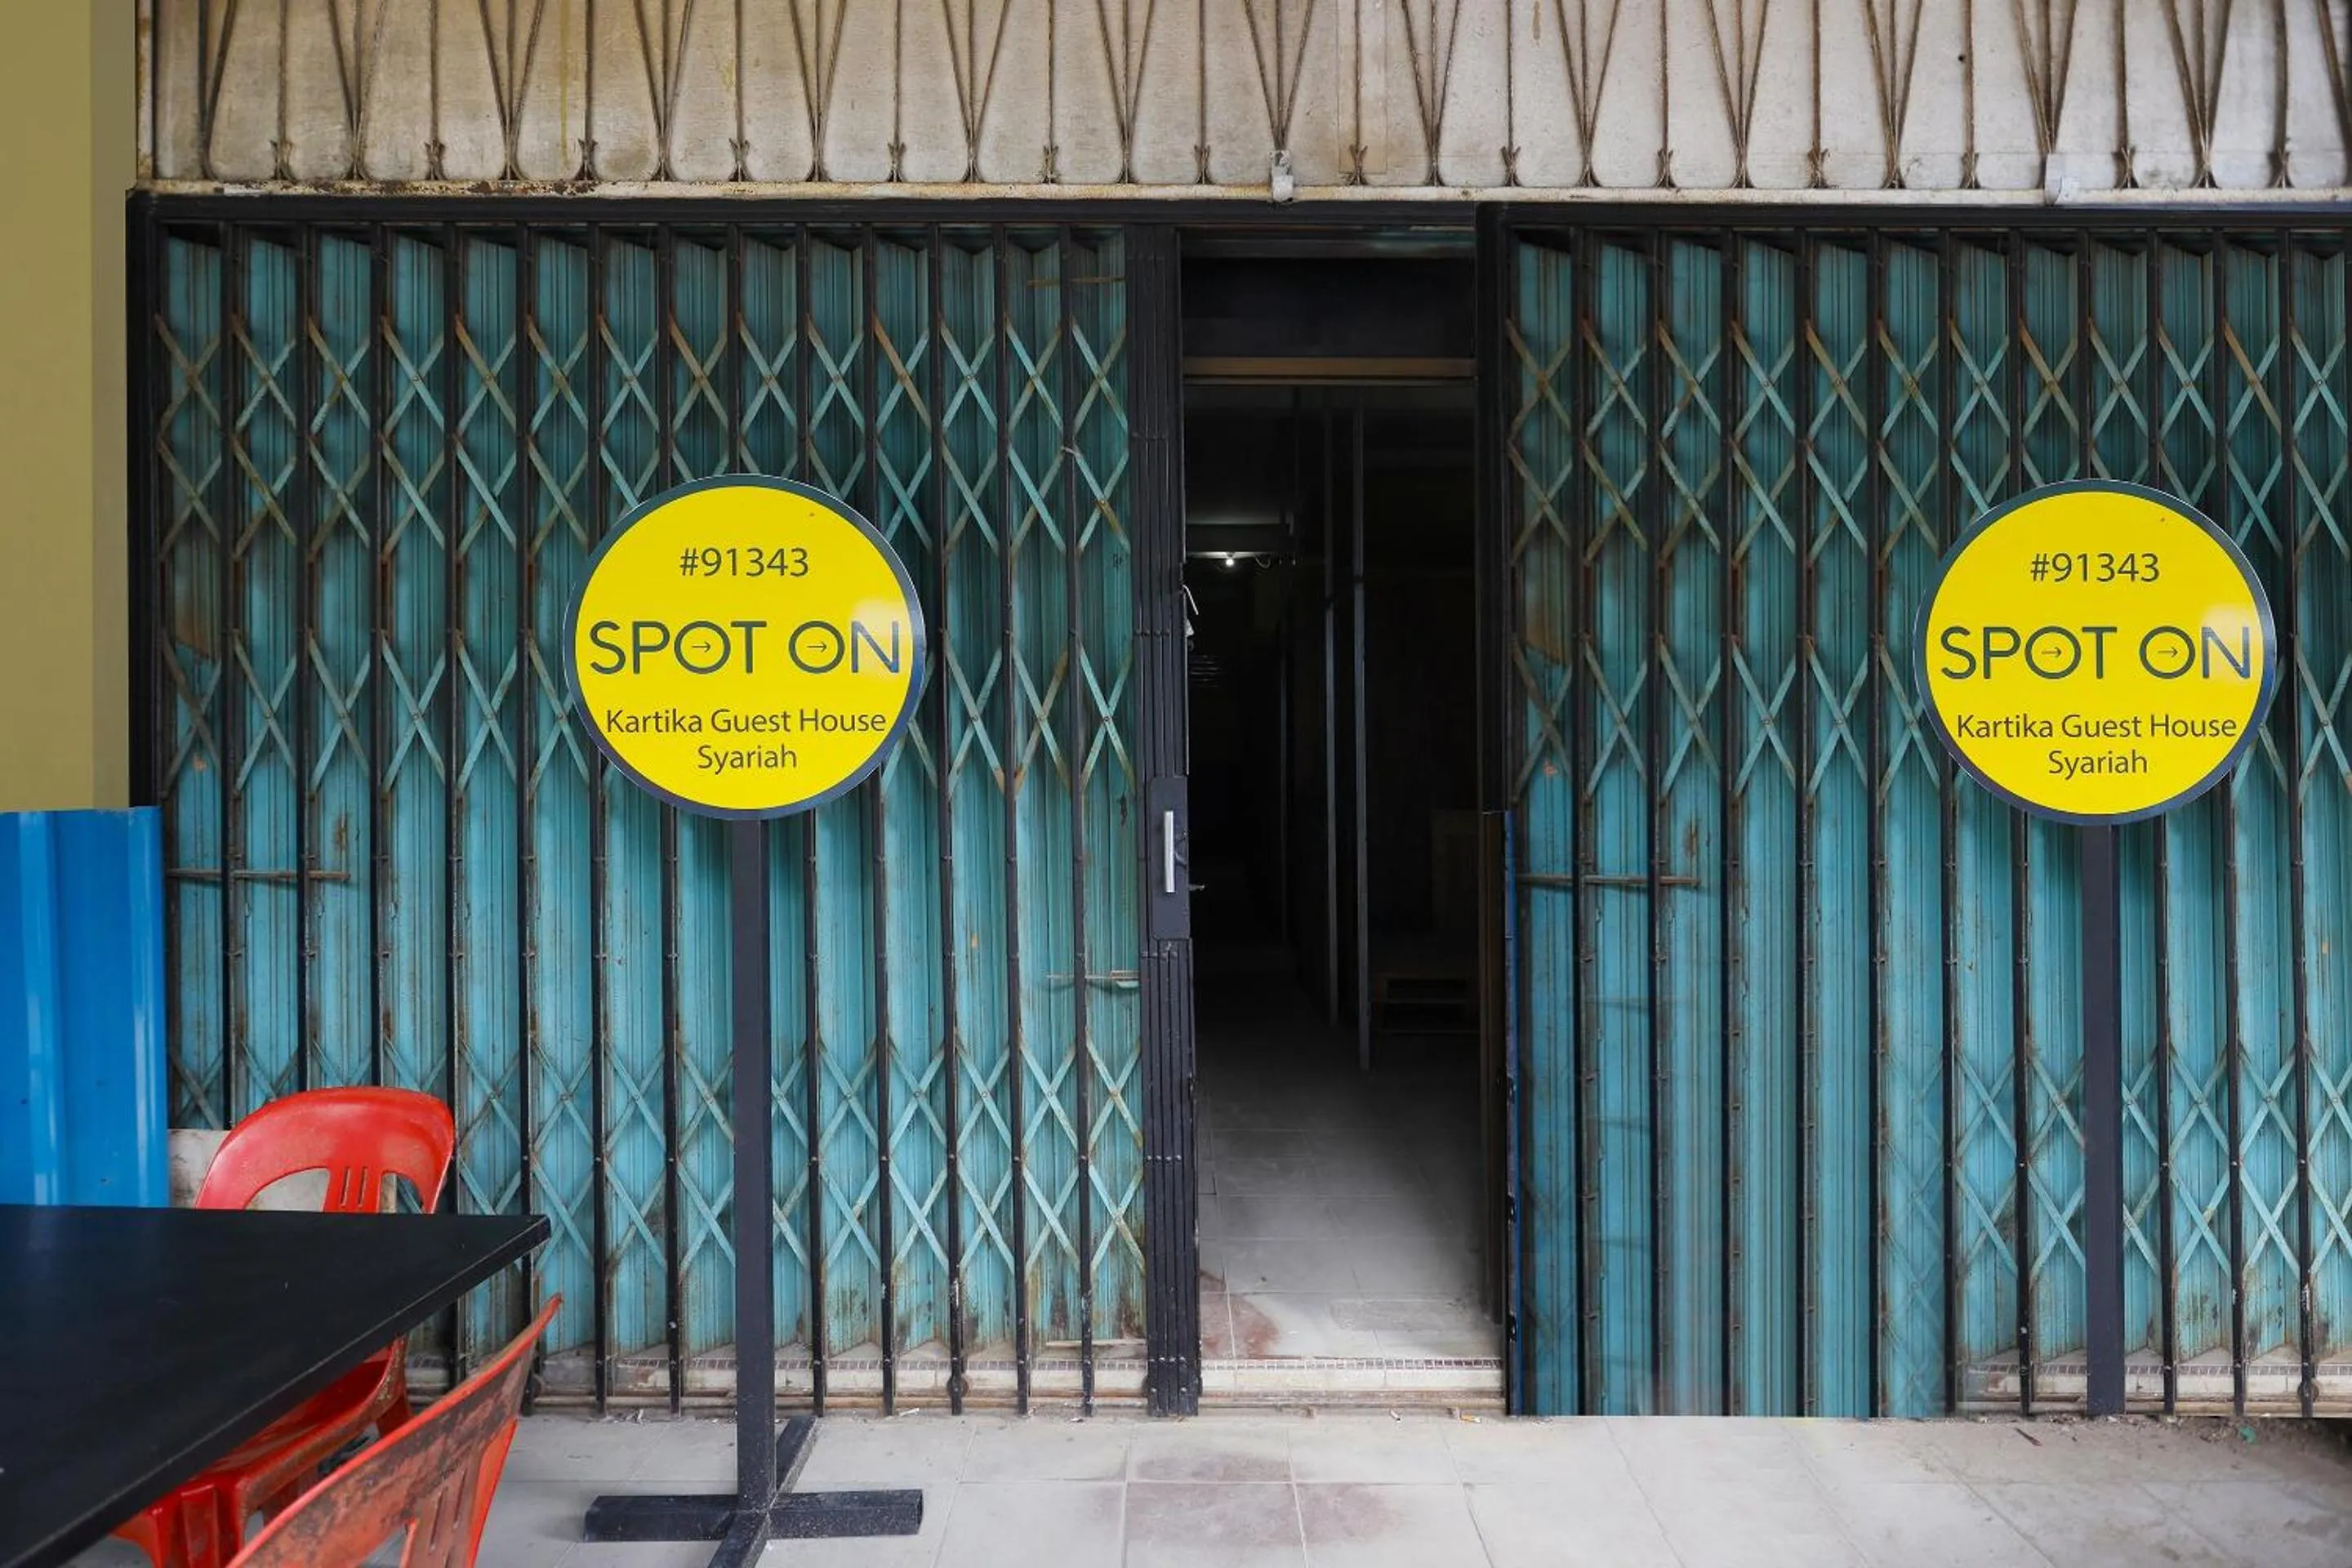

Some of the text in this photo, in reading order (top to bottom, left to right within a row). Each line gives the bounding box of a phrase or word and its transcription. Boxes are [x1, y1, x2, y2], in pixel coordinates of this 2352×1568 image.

[679, 547, 809, 577] #91343
[2030, 552, 2160, 582] #91343
[589, 620, 900, 675] SPOT ON
[1940, 626, 2251, 680] SPOT ON
[606, 708, 887, 733] Kartika Guest House
[1957, 713, 2237, 738] Kartika Guest House
[697, 744, 797, 775] Syariah
[2048, 749, 2148, 780] Syariah
